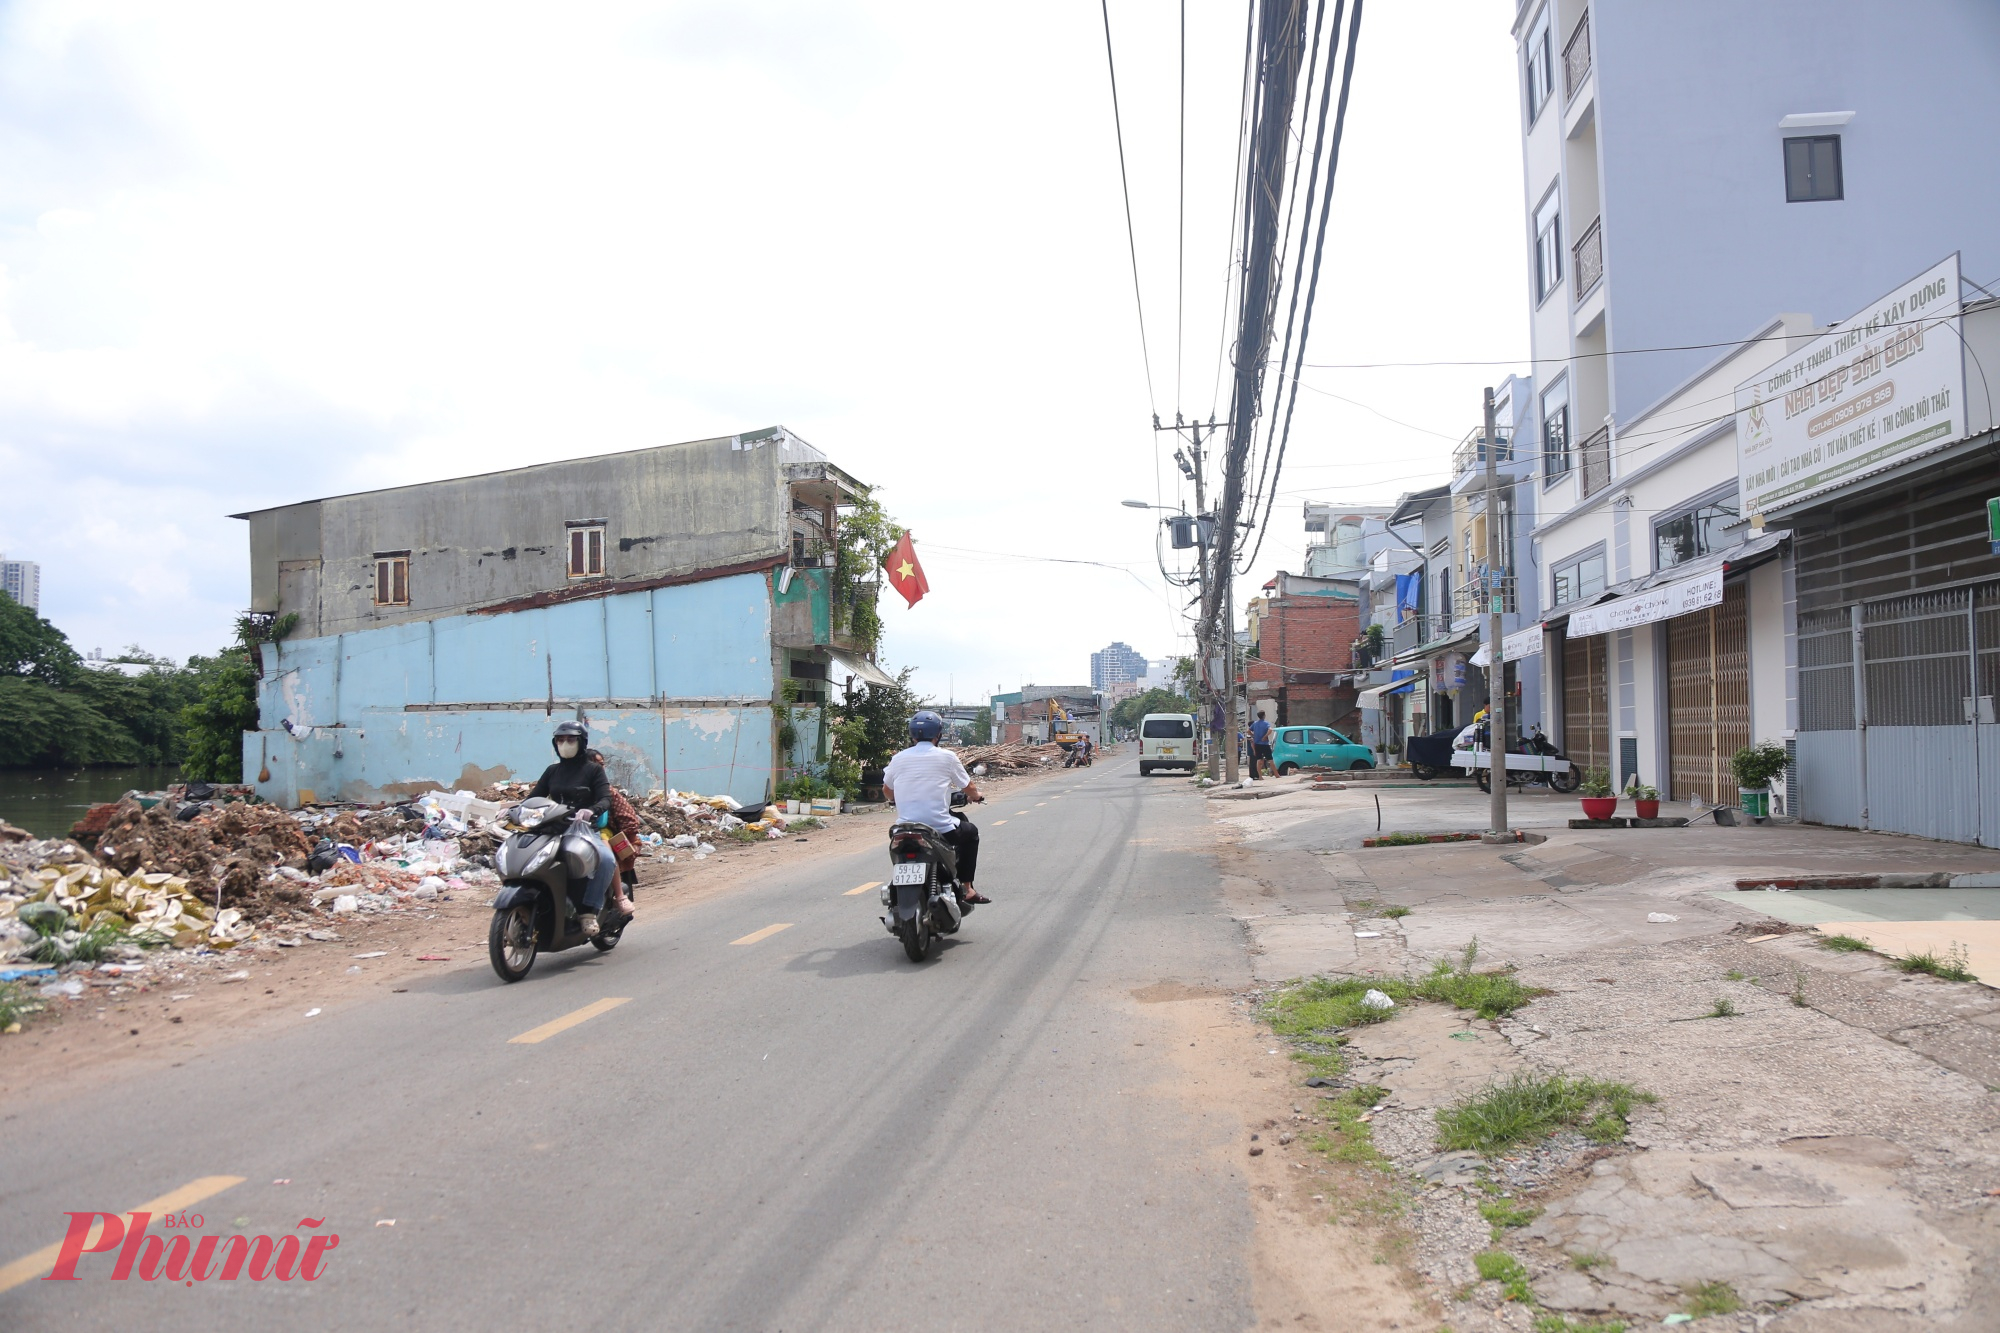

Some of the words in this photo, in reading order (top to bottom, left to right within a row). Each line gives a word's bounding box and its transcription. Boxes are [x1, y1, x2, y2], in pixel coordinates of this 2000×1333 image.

[1768, 369, 1792, 393] CÔNG
[1793, 361, 1804, 379] TY
[1807, 345, 1832, 371] TNHH
[1865, 310, 1880, 338] KẾ
[1883, 300, 1906, 327] XÂY
[1910, 277, 1946, 312] DỰNG
[1785, 378, 1815, 420] NHÀ
[1852, 344, 1881, 386] SÀI
[1809, 417, 1832, 434] HOTLINE
[1834, 405, 1854, 422] 0909
[1855, 396, 1872, 412] 978
[1874, 386, 1892, 403] 368
[1867, 416, 1876, 441] KẾ
[1883, 414, 1893, 434] THI
[1895, 405, 1914, 429] CÔNG
[1916, 396, 1930, 421] NỘI
[1931, 384, 1950, 414] THẤT
[895, 874, 923, 884] 912.35
[898, 865, 921, 874] 59-L2
